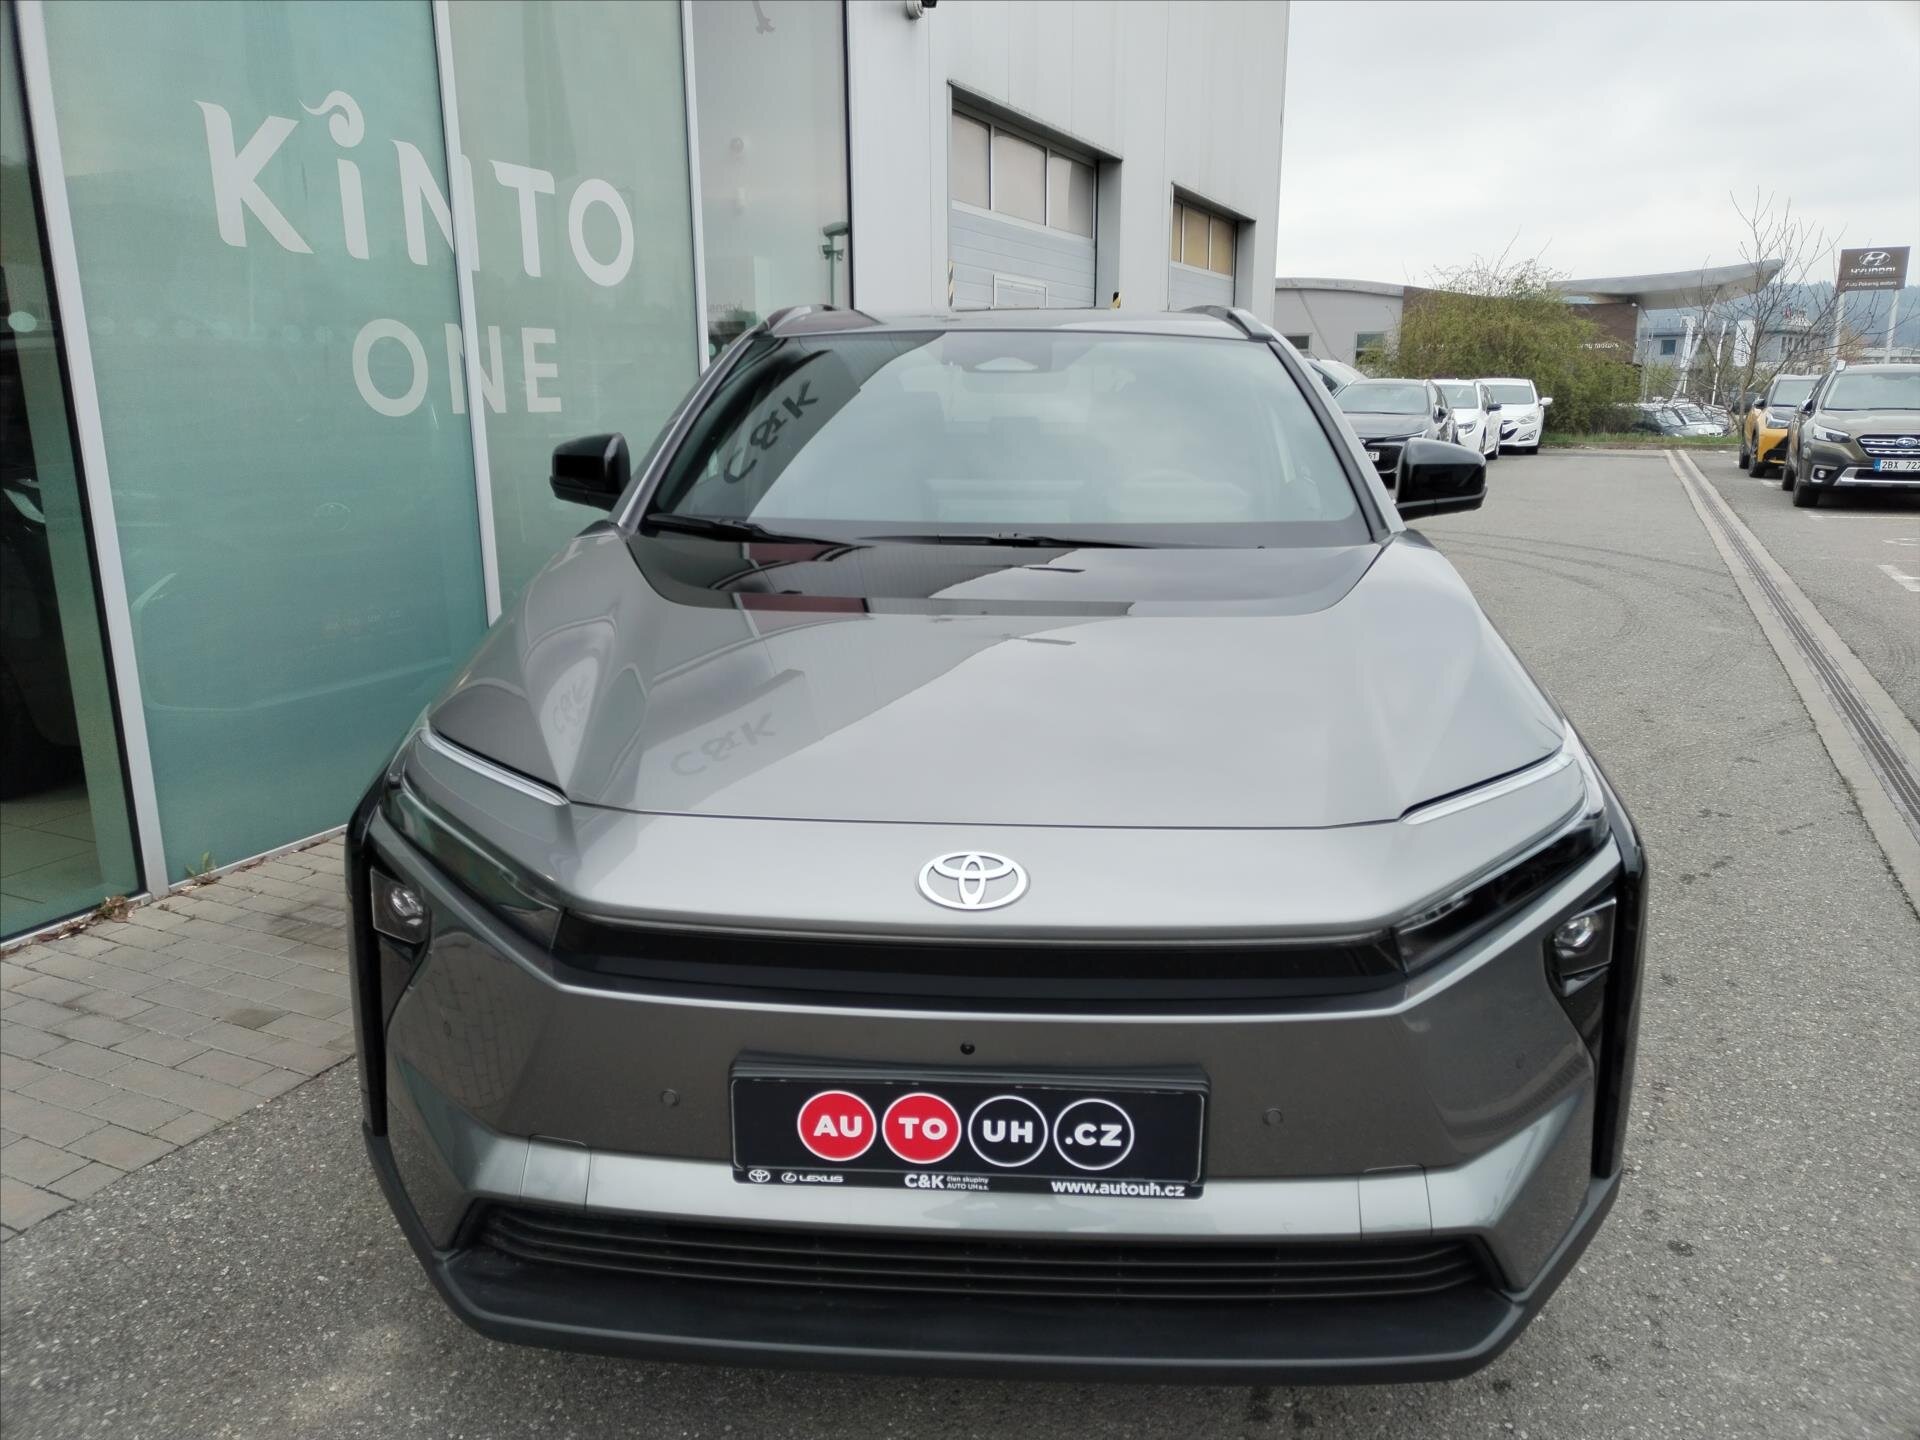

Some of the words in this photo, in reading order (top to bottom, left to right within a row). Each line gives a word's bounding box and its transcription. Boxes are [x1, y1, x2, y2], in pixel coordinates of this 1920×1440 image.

[352, 318, 562, 417] ONE
[813, 1114, 863, 1138] AU
[898, 1117, 948, 1140] TO
[982, 1119, 1033, 1143] UH
[799, 1174, 844, 1183] LEXUS
[904, 1173, 945, 1189] C&K
[946, 1182, 967, 1190] AUTO
[1051, 1181, 1185, 1197] www.autouh.cz
